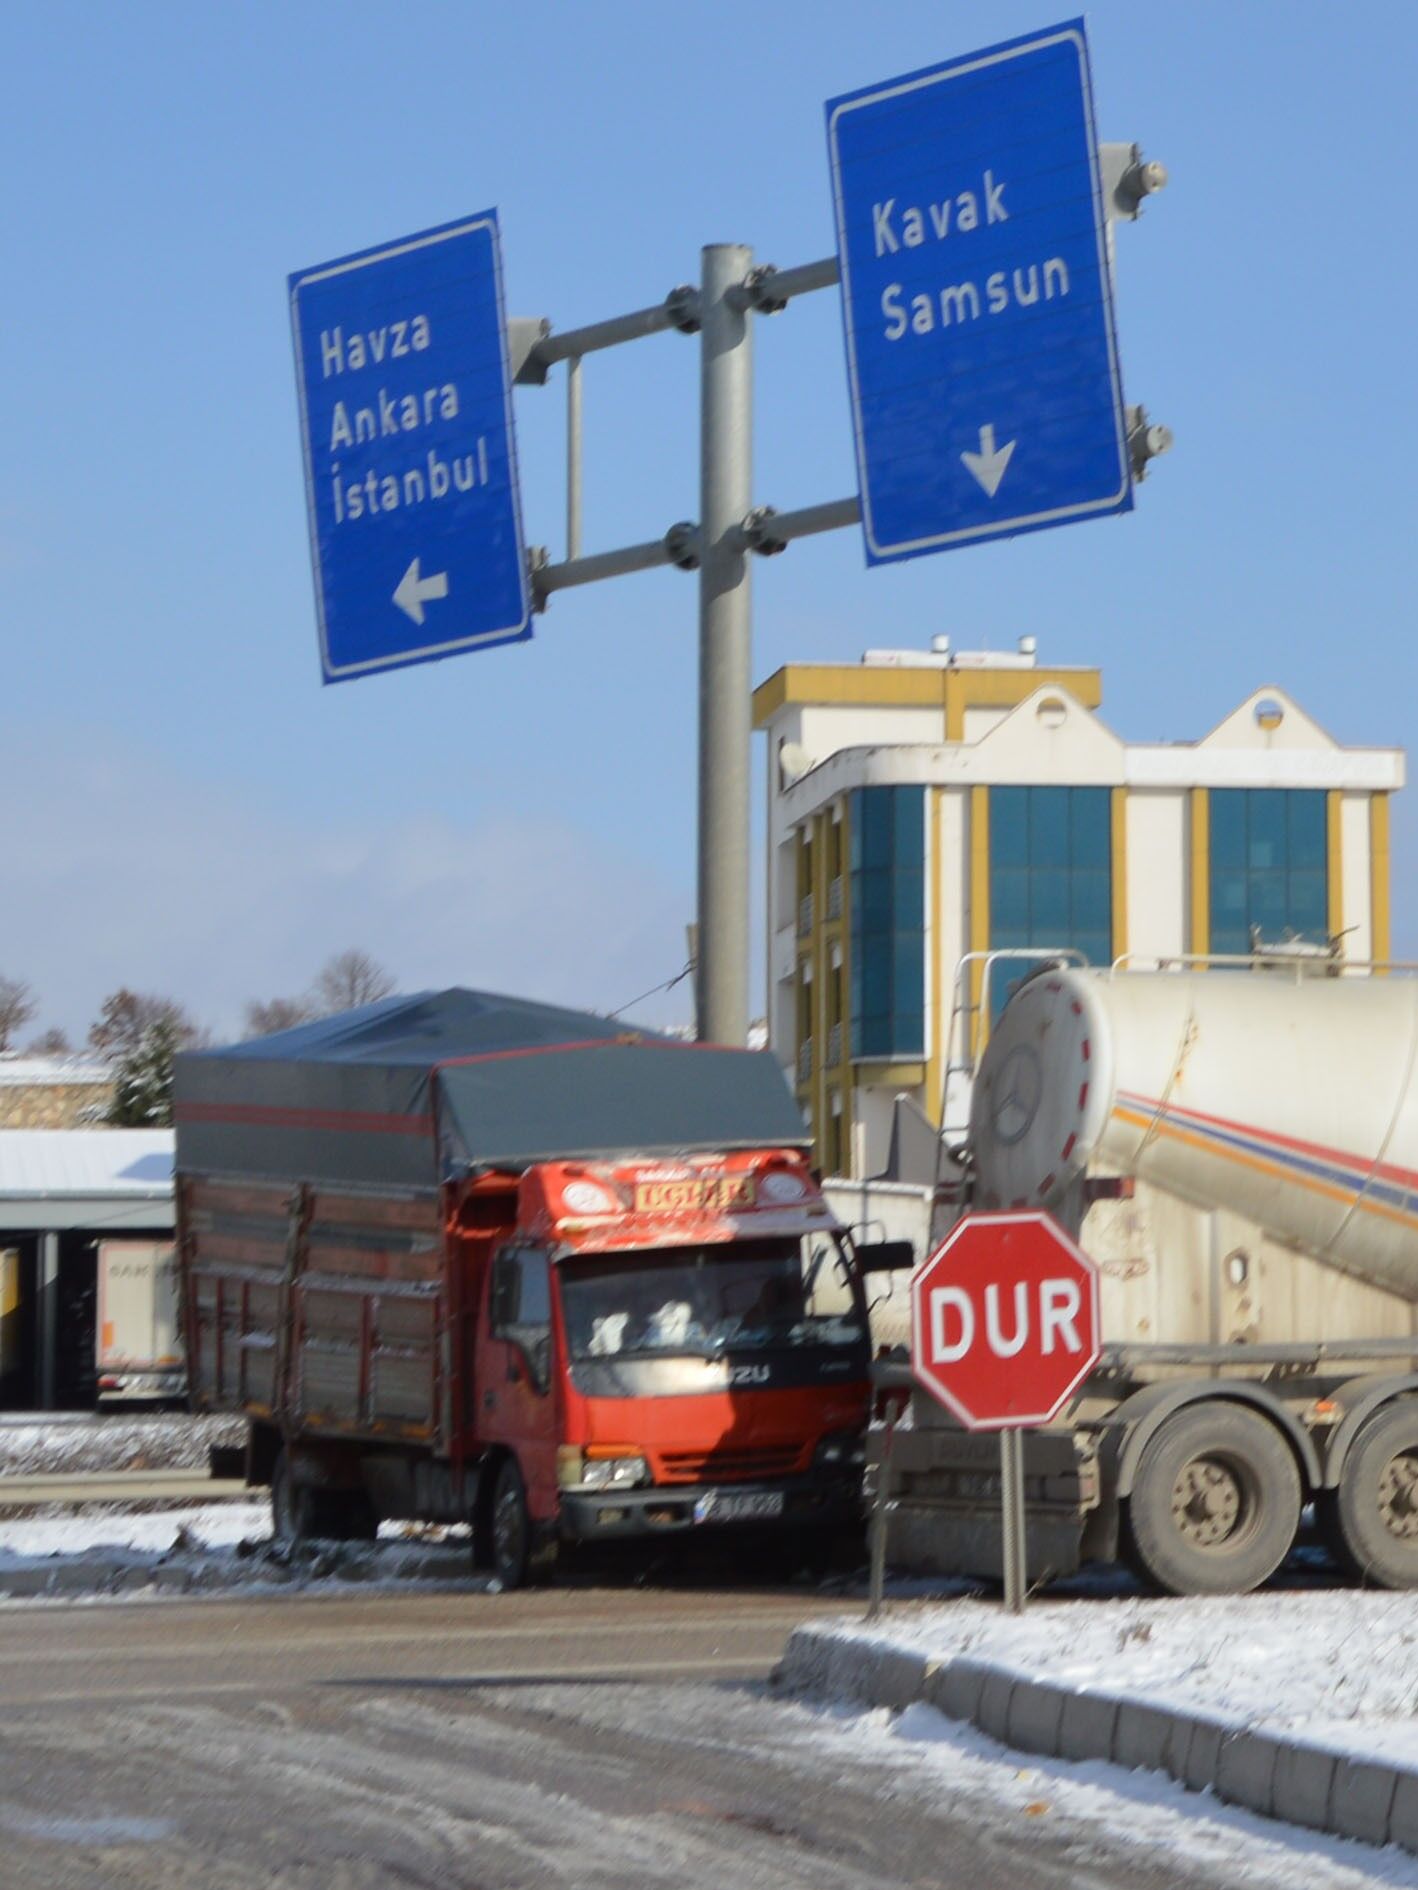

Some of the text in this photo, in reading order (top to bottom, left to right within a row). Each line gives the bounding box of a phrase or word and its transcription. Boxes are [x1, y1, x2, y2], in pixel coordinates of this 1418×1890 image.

[872, 169, 1009, 258] Kavak
[880, 256, 1071, 342] Samsun
[319, 314, 431, 379] Havza
[329, 382, 460, 453] Ankara
[330, 436, 490, 525] İstanbul
[929, 1277, 1083, 1365] DUR
